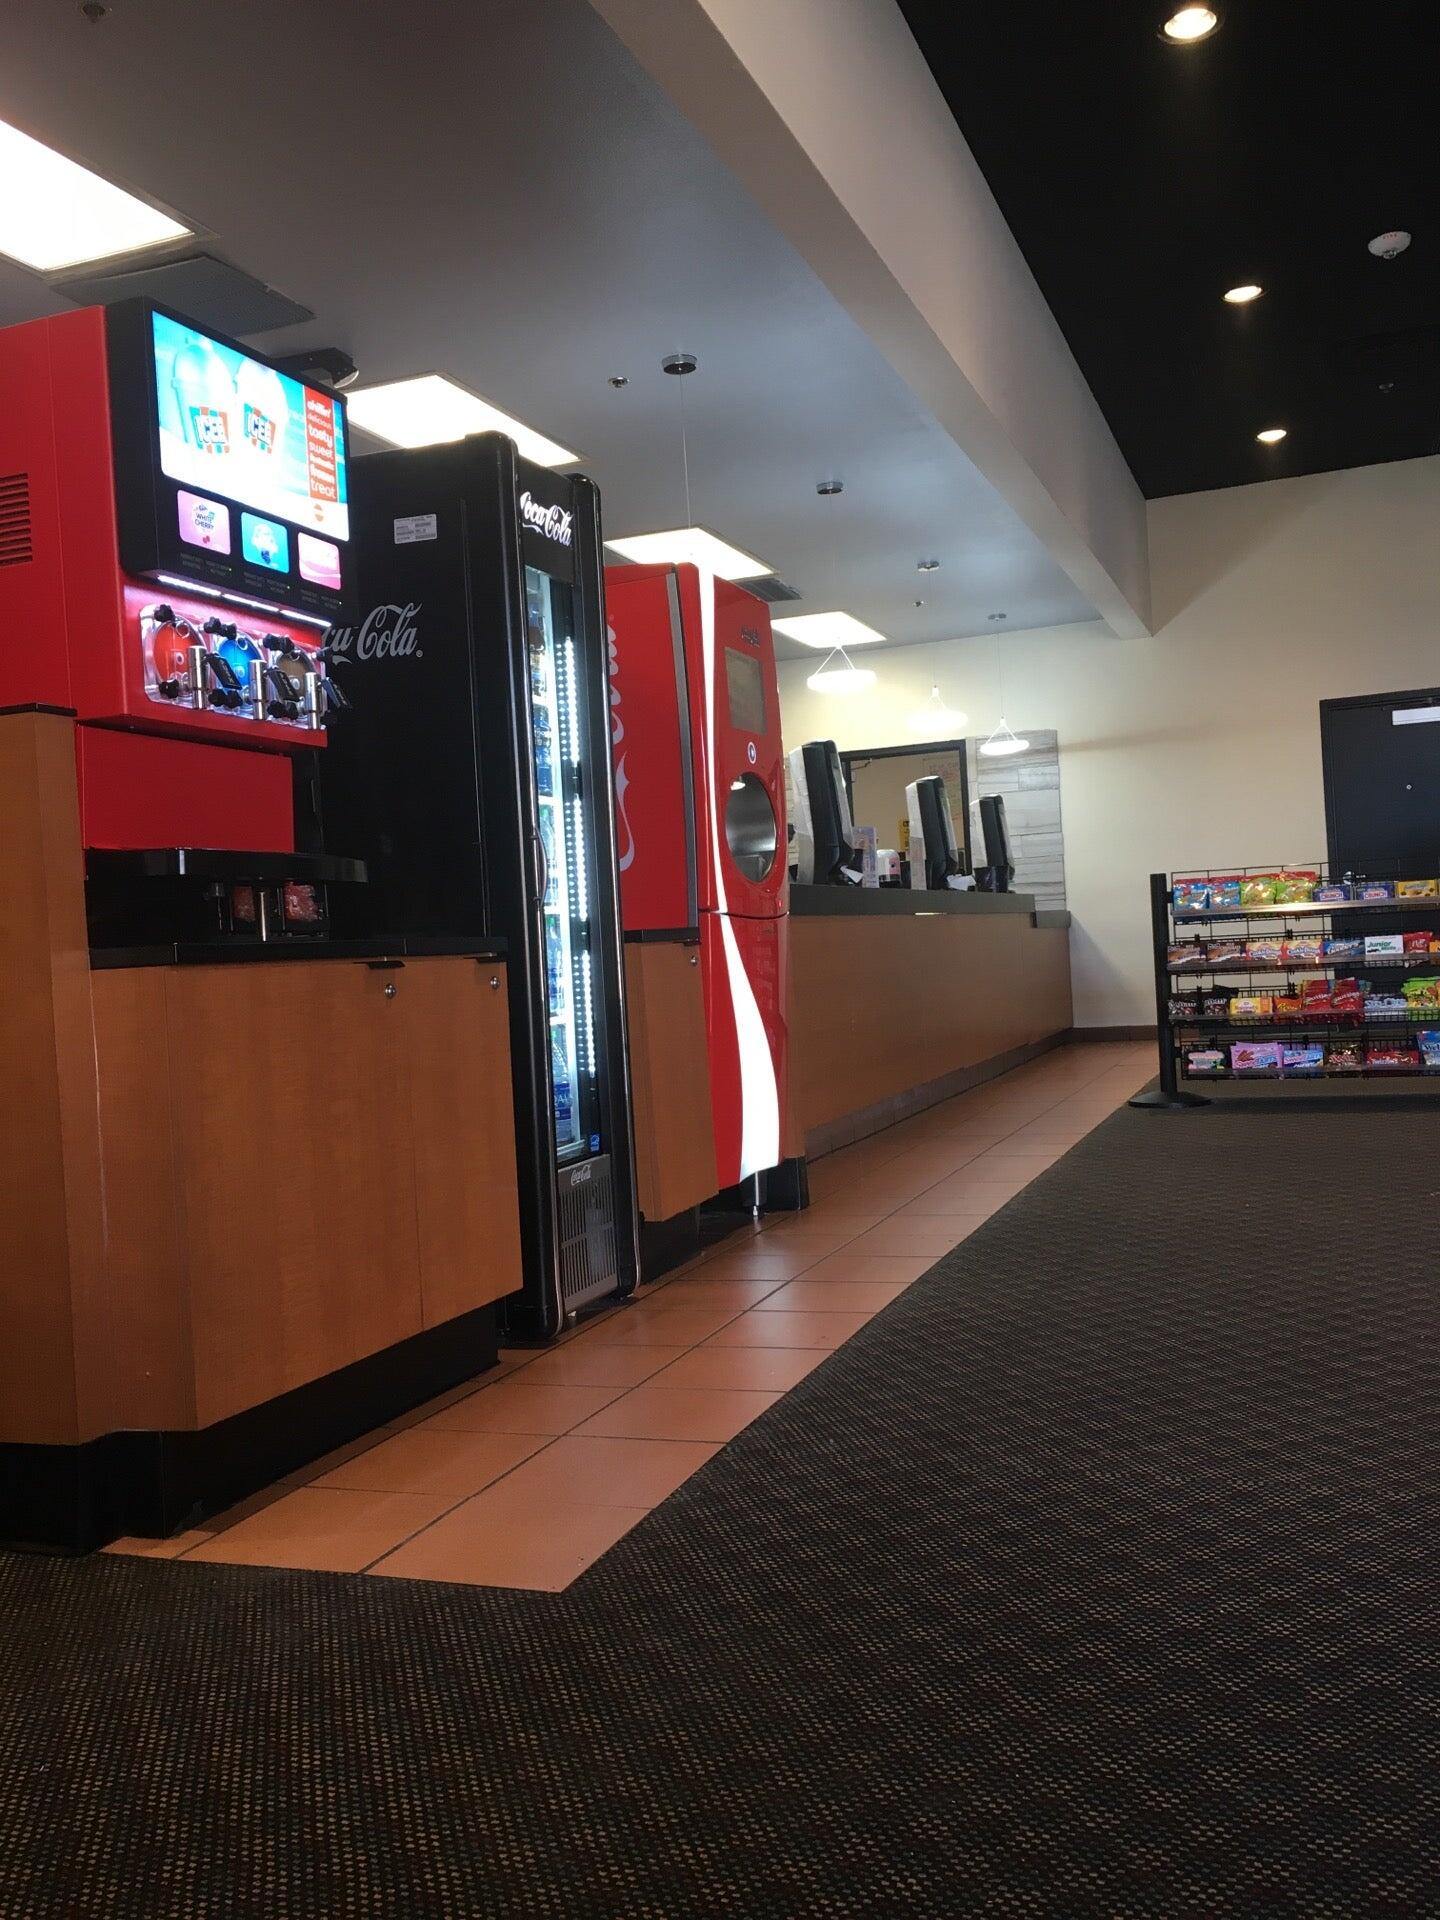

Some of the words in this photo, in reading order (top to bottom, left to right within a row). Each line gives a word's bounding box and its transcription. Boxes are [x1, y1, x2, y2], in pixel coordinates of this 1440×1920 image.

[311, 478, 336, 499] treat
[196, 512, 213, 523] WHITE
[195, 519, 214, 529] CHERRY
[1367, 940, 1392, 948] Junior
